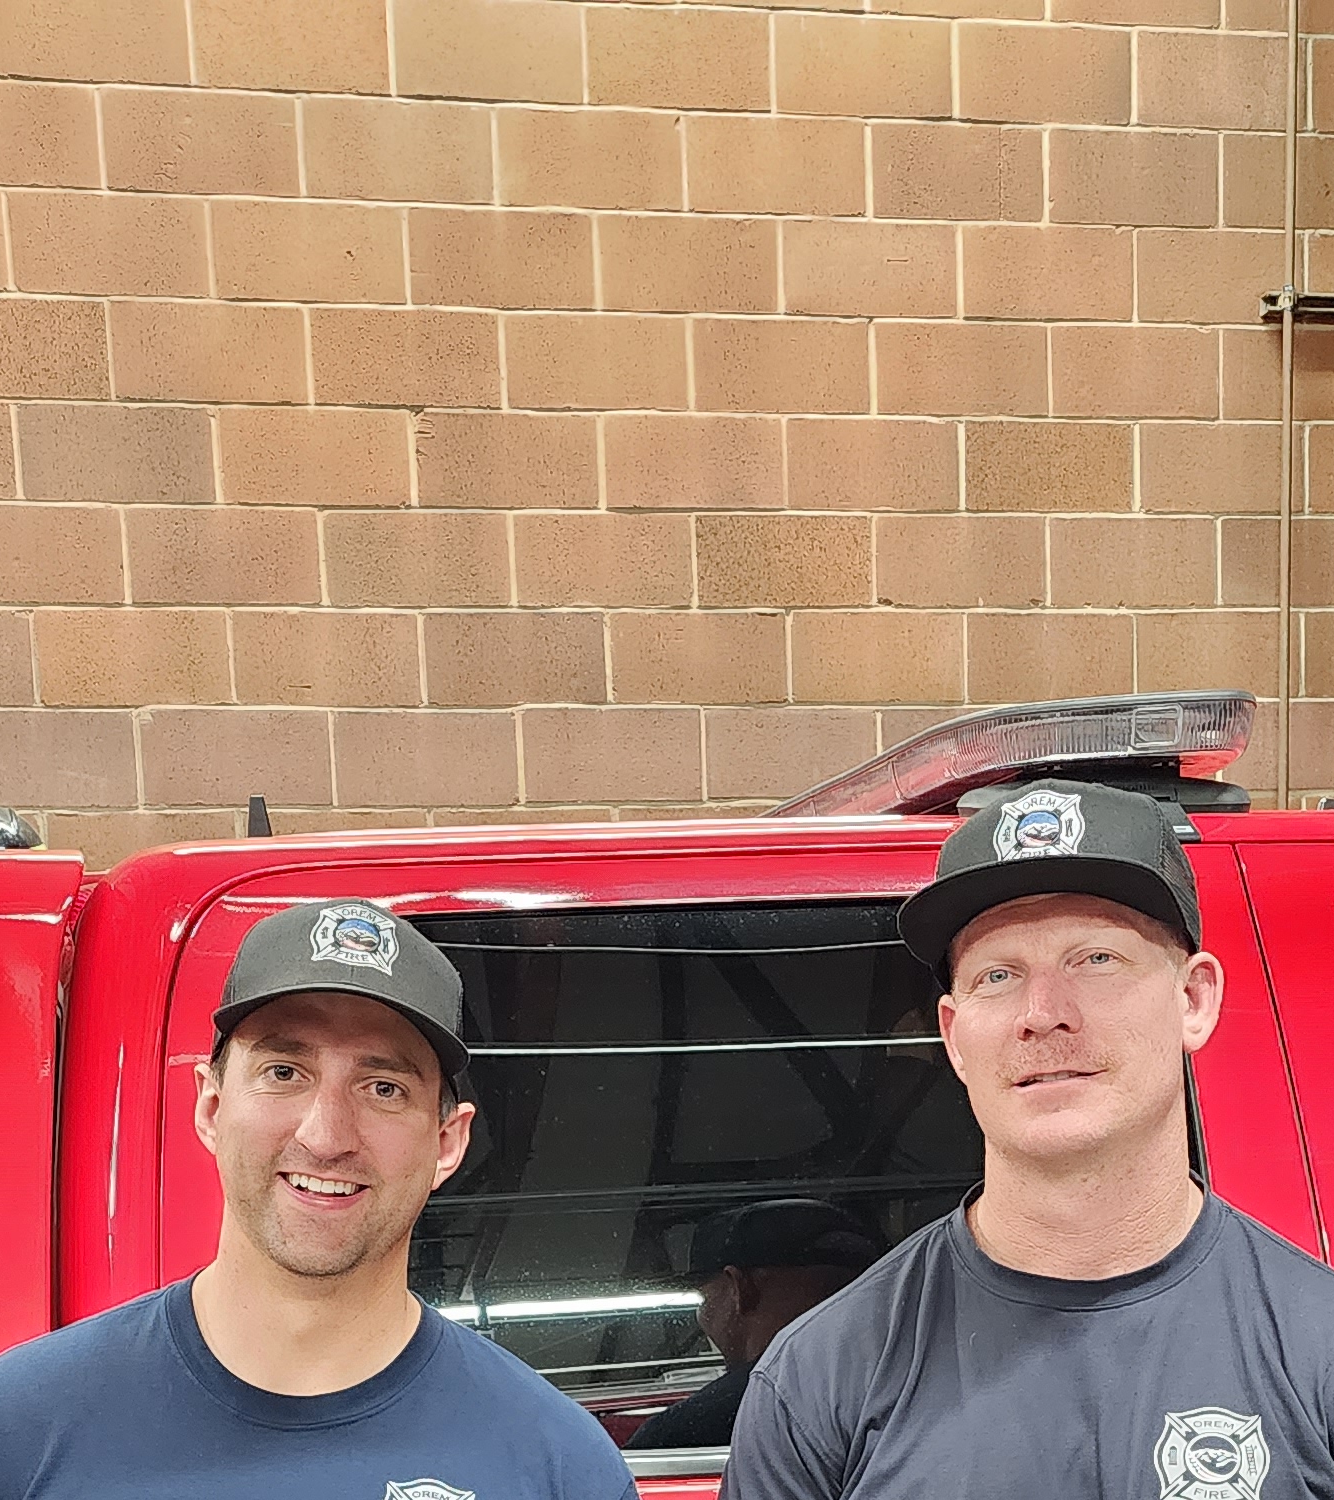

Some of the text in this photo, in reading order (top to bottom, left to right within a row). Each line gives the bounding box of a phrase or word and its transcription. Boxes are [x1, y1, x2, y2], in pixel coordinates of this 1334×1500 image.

[1022, 796, 1056, 810] OREM
[342, 908, 377, 921] OREM
[335, 950, 369, 962] FIRE
[1193, 1420, 1235, 1430] OREM
[1193, 1487, 1231, 1500] FIRE
